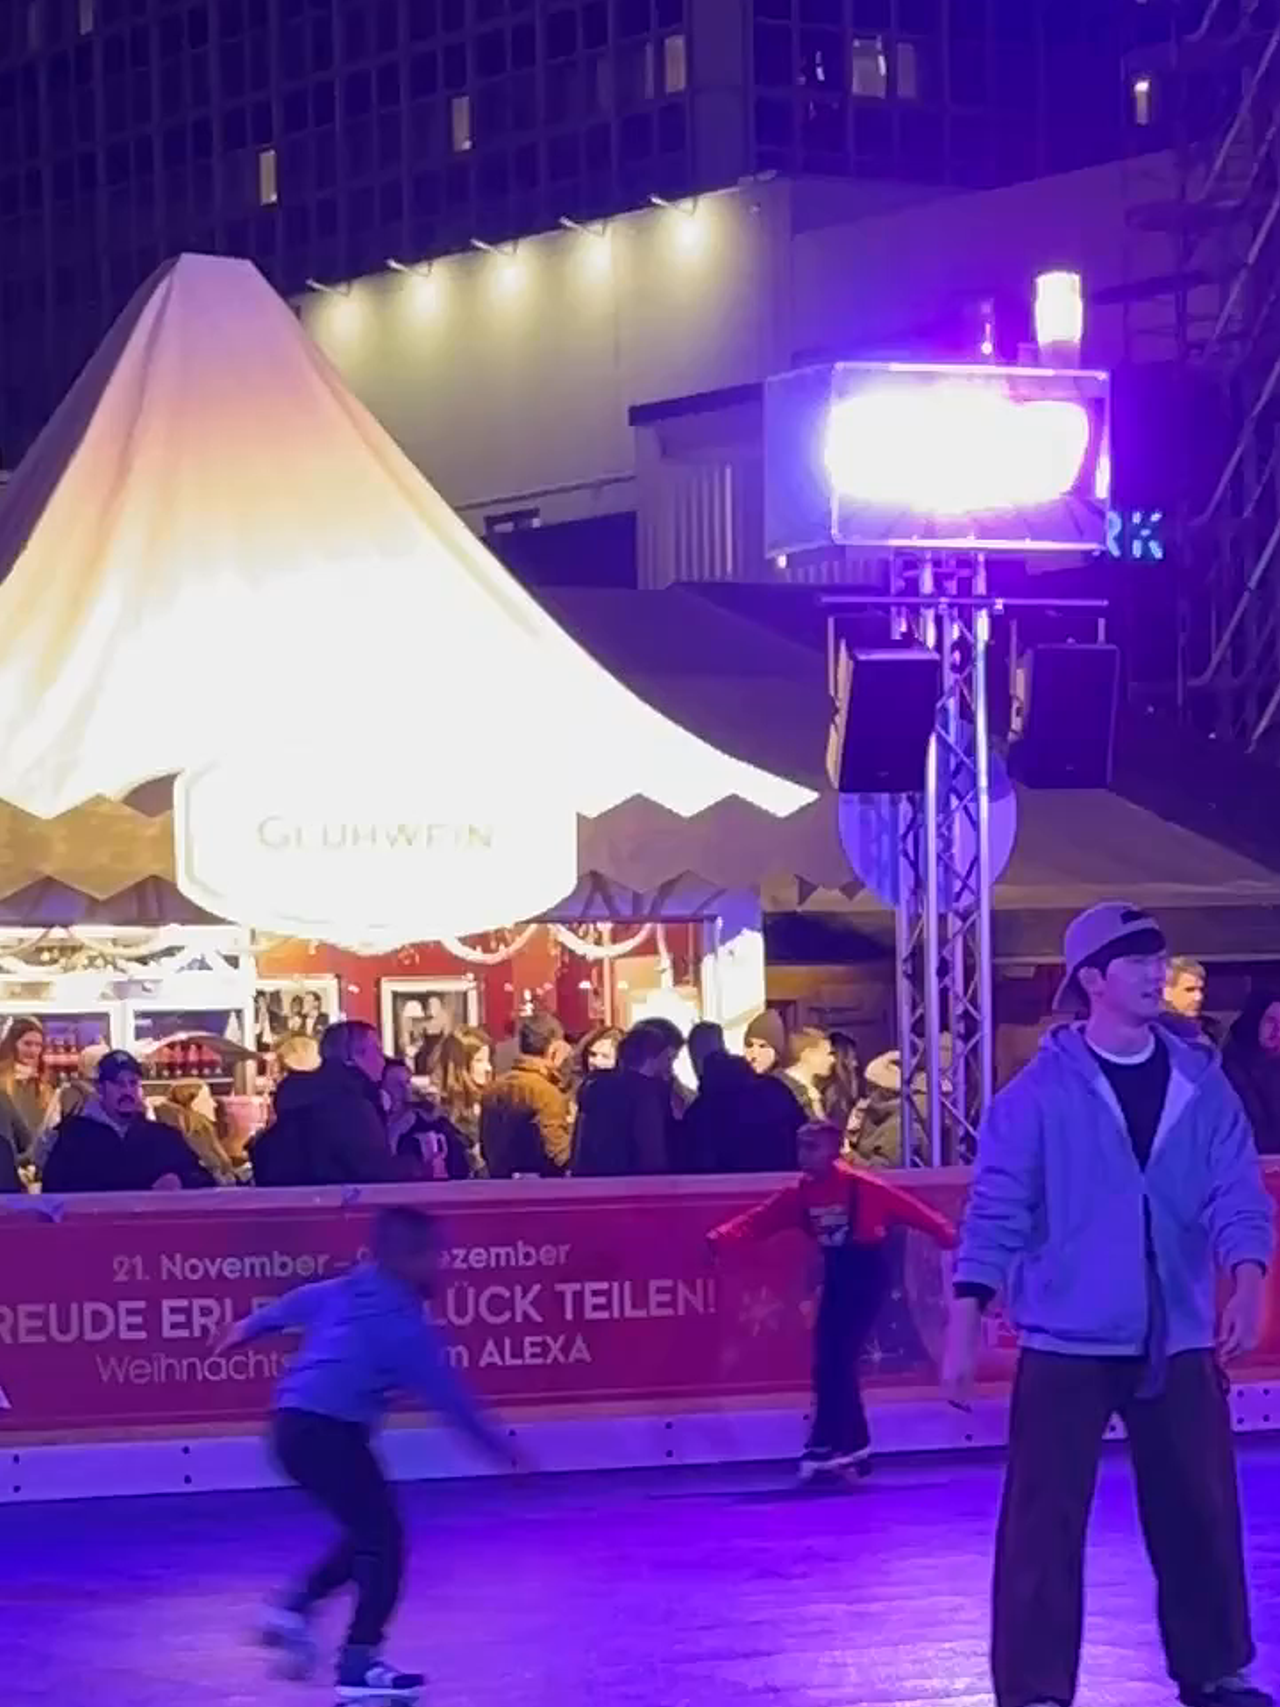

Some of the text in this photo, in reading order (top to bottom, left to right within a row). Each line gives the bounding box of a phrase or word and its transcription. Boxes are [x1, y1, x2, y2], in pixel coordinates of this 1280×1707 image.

[160, 1250, 330, 1282] November
[422, 1281, 544, 1326] LÜCK
[554, 1278, 716, 1321] TEILEN!
[478, 1335, 593, 1368] ALEXA
